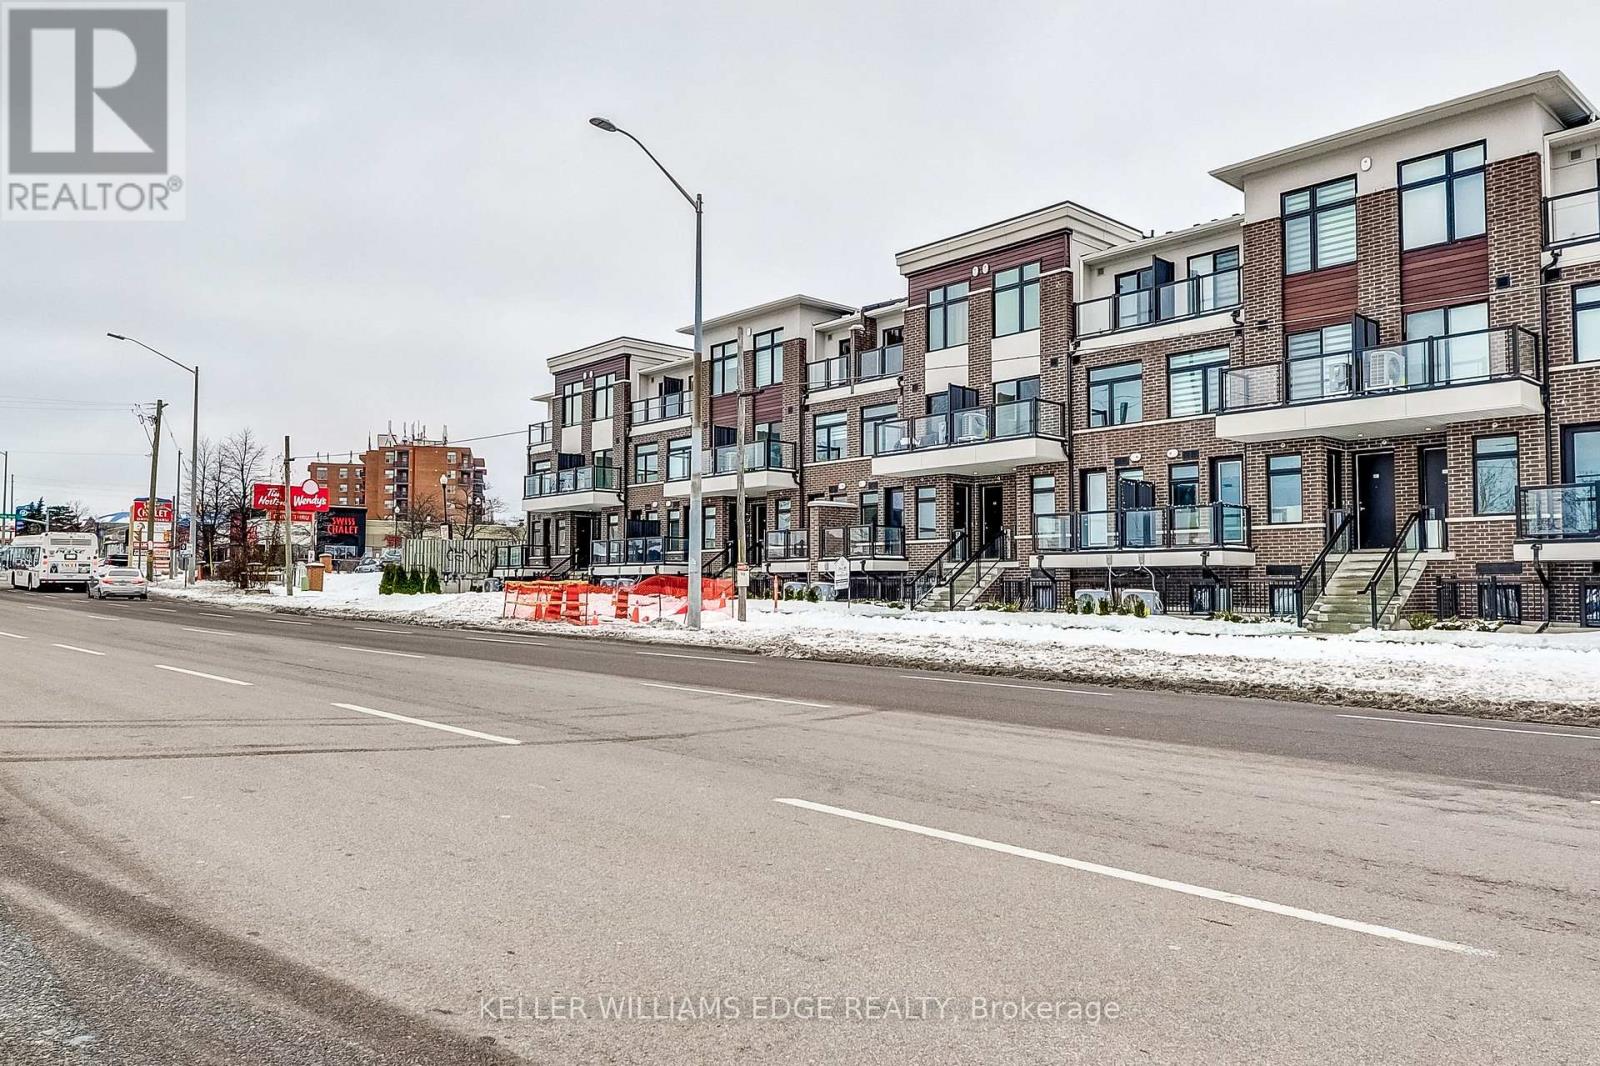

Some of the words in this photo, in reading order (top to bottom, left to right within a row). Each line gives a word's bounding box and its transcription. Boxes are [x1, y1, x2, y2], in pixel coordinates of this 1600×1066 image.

[137, 507, 168, 518] CHLET
[331, 516, 356, 525] SWISS
[327, 525, 359, 534] CHALET
